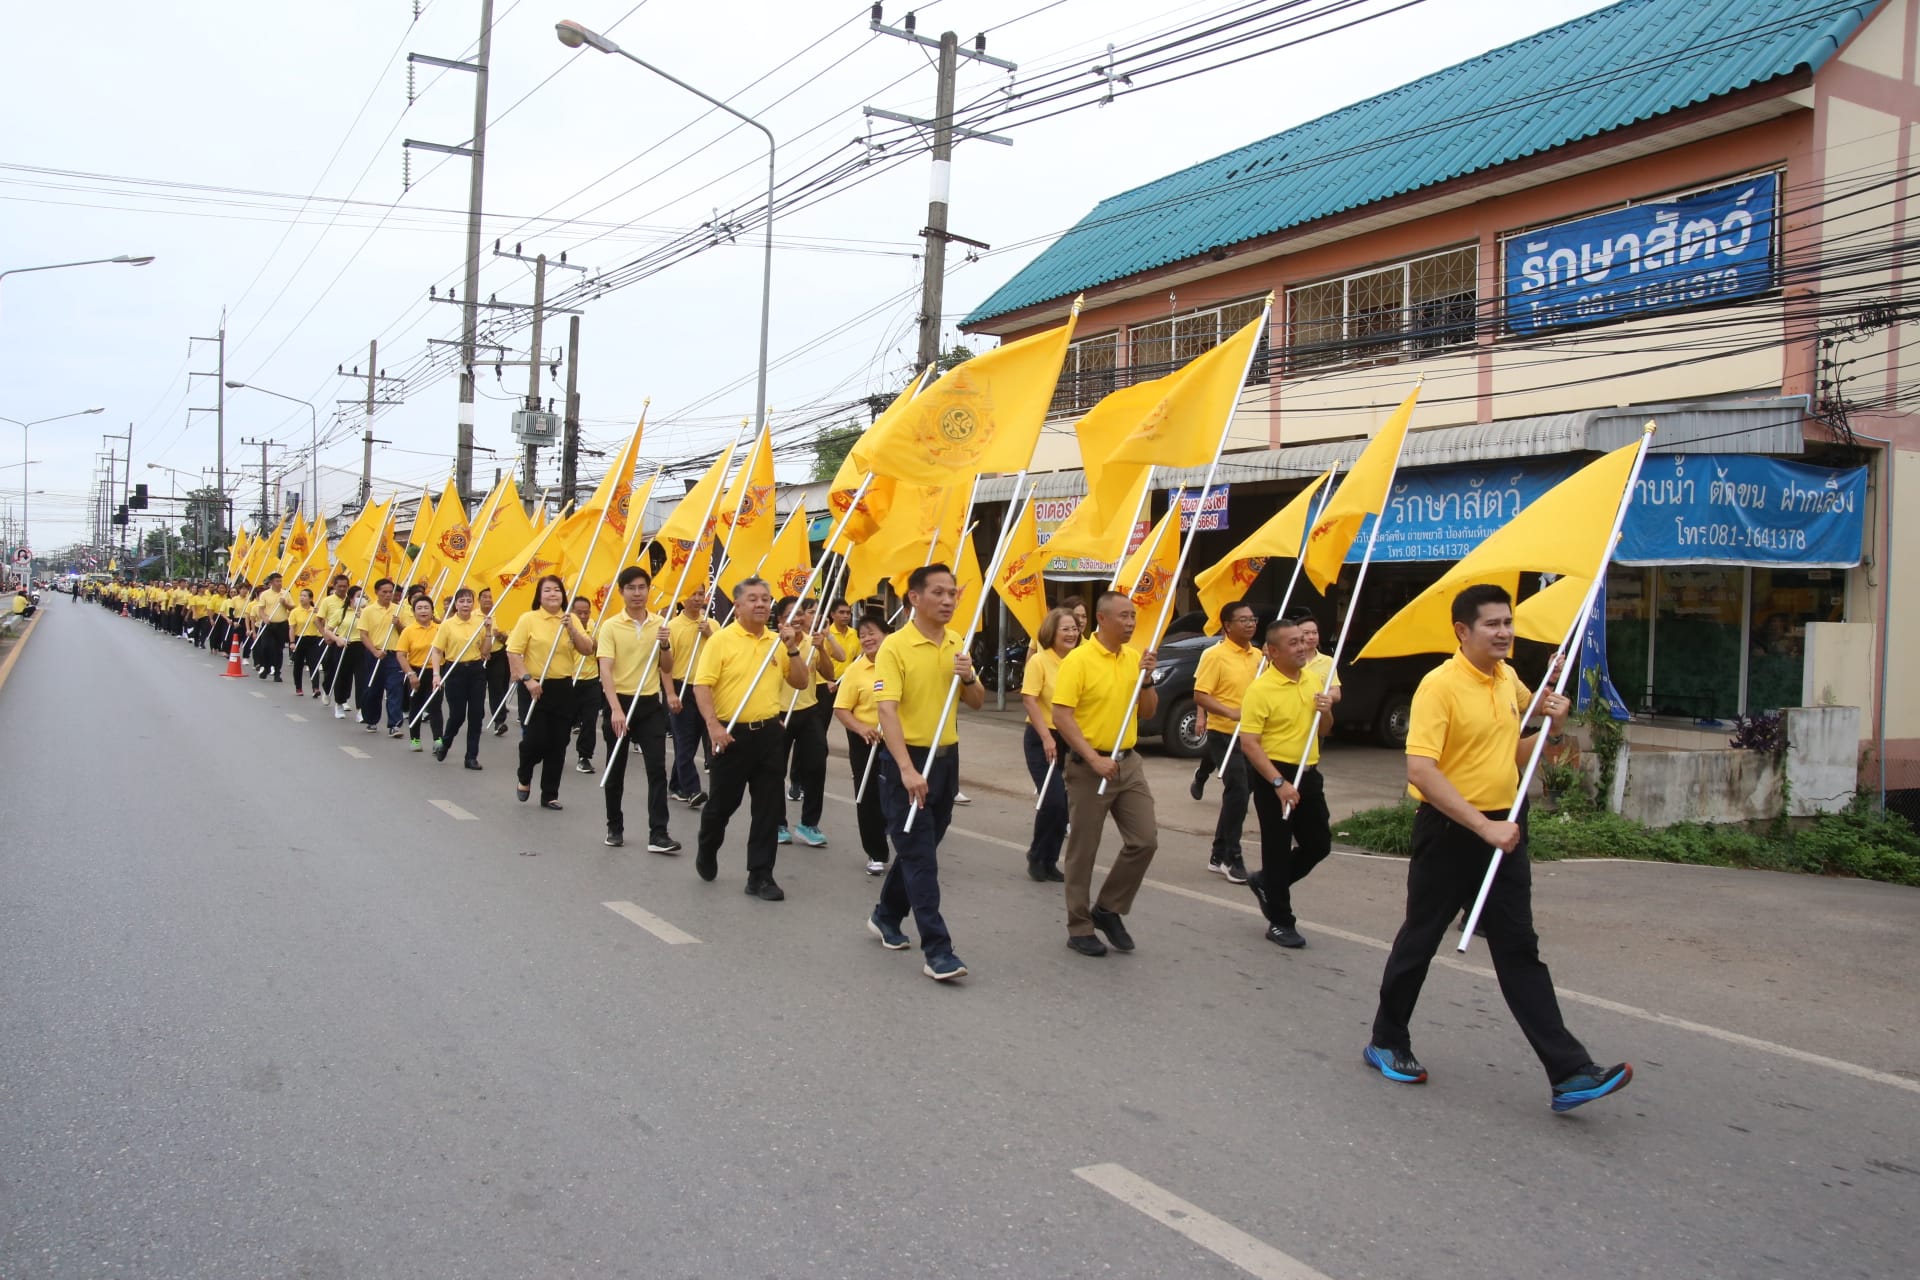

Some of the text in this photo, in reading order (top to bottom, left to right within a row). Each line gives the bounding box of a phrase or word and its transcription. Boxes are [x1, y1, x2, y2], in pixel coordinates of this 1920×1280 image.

[1521, 187, 1755, 295] รักษาสัตว์
[1391, 473, 1523, 524] รักษาสัตว์
[1629, 455, 1694, 505] าบน้ำ
[1710, 468, 1766, 508] ตัดขน
